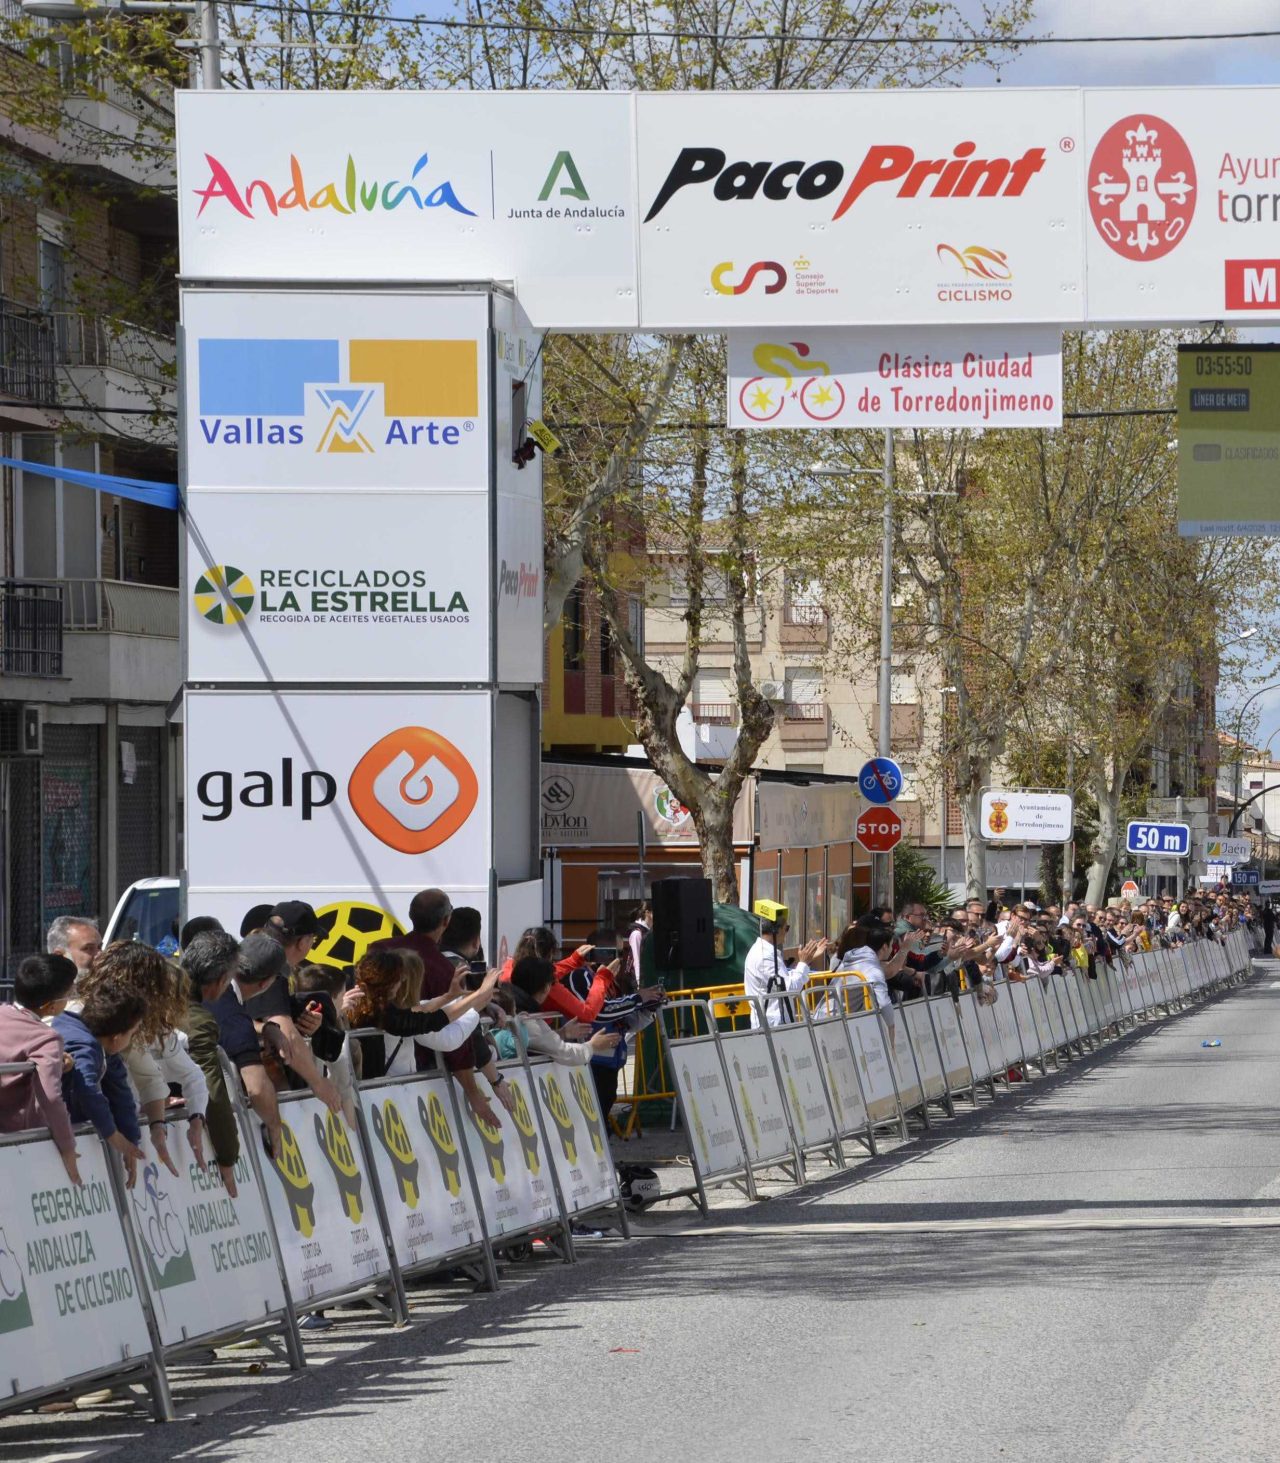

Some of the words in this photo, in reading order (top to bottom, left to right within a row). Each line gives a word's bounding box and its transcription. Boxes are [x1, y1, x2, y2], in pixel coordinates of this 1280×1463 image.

[192, 152, 479, 219] Andalucía
[643, 147, 844, 224] Paco
[832, 141, 1047, 221] Print
[507, 207, 541, 221] Junta
[546, 207, 561, 219] de
[564, 206, 625, 219] Andalucía
[795, 273, 824, 282] Consejo
[795, 280, 826, 289] Superior
[806, 287, 839, 296] Deportes
[938, 290, 1012, 301] CICLISMO
[878, 352, 953, 379] Clásica
[962, 352, 1033, 378] Ciudad
[1196, 356, 1252, 376] 03:55:50
[858, 389, 880, 413] de
[891, 386, 1054, 419] Torredonjimeno
[200, 418, 304, 445] Vallas
[260, 570, 427, 588] RECICLADOS
[260, 591, 301, 612] LA
[311, 591, 470, 612] ESTRELLA
[260, 615, 310, 623] RECOGIDA
[313, 615, 326, 623] DE
[329, 615, 369, 623] ACEITES
[372, 615, 428, 623] VEGETALES
[430, 615, 470, 623] USADOS
[197, 757, 338, 821] galp
[1018, 804, 1062, 812] Ayuntamiento
[858, 823, 901, 835] STOP
[1015, 821, 1064, 830] Torredonjimeno
[1136, 827, 1159, 849] 50
[1164, 834, 1180, 850] m
[1222, 842, 1246, 854] Jaén
[1234, 874, 1247, 883] 150
[31, 1175, 111, 1226] FEDERACIÓN
[187, 1198, 240, 1236] ANDALUZA
[26, 1229, 97, 1275] ANDALUZA
[211, 1240, 229, 1273] DE
[228, 1231, 272, 1266] CICLISMO
[55, 1280, 78, 1317] DE
[75, 1267, 133, 1310] CICLISMO
